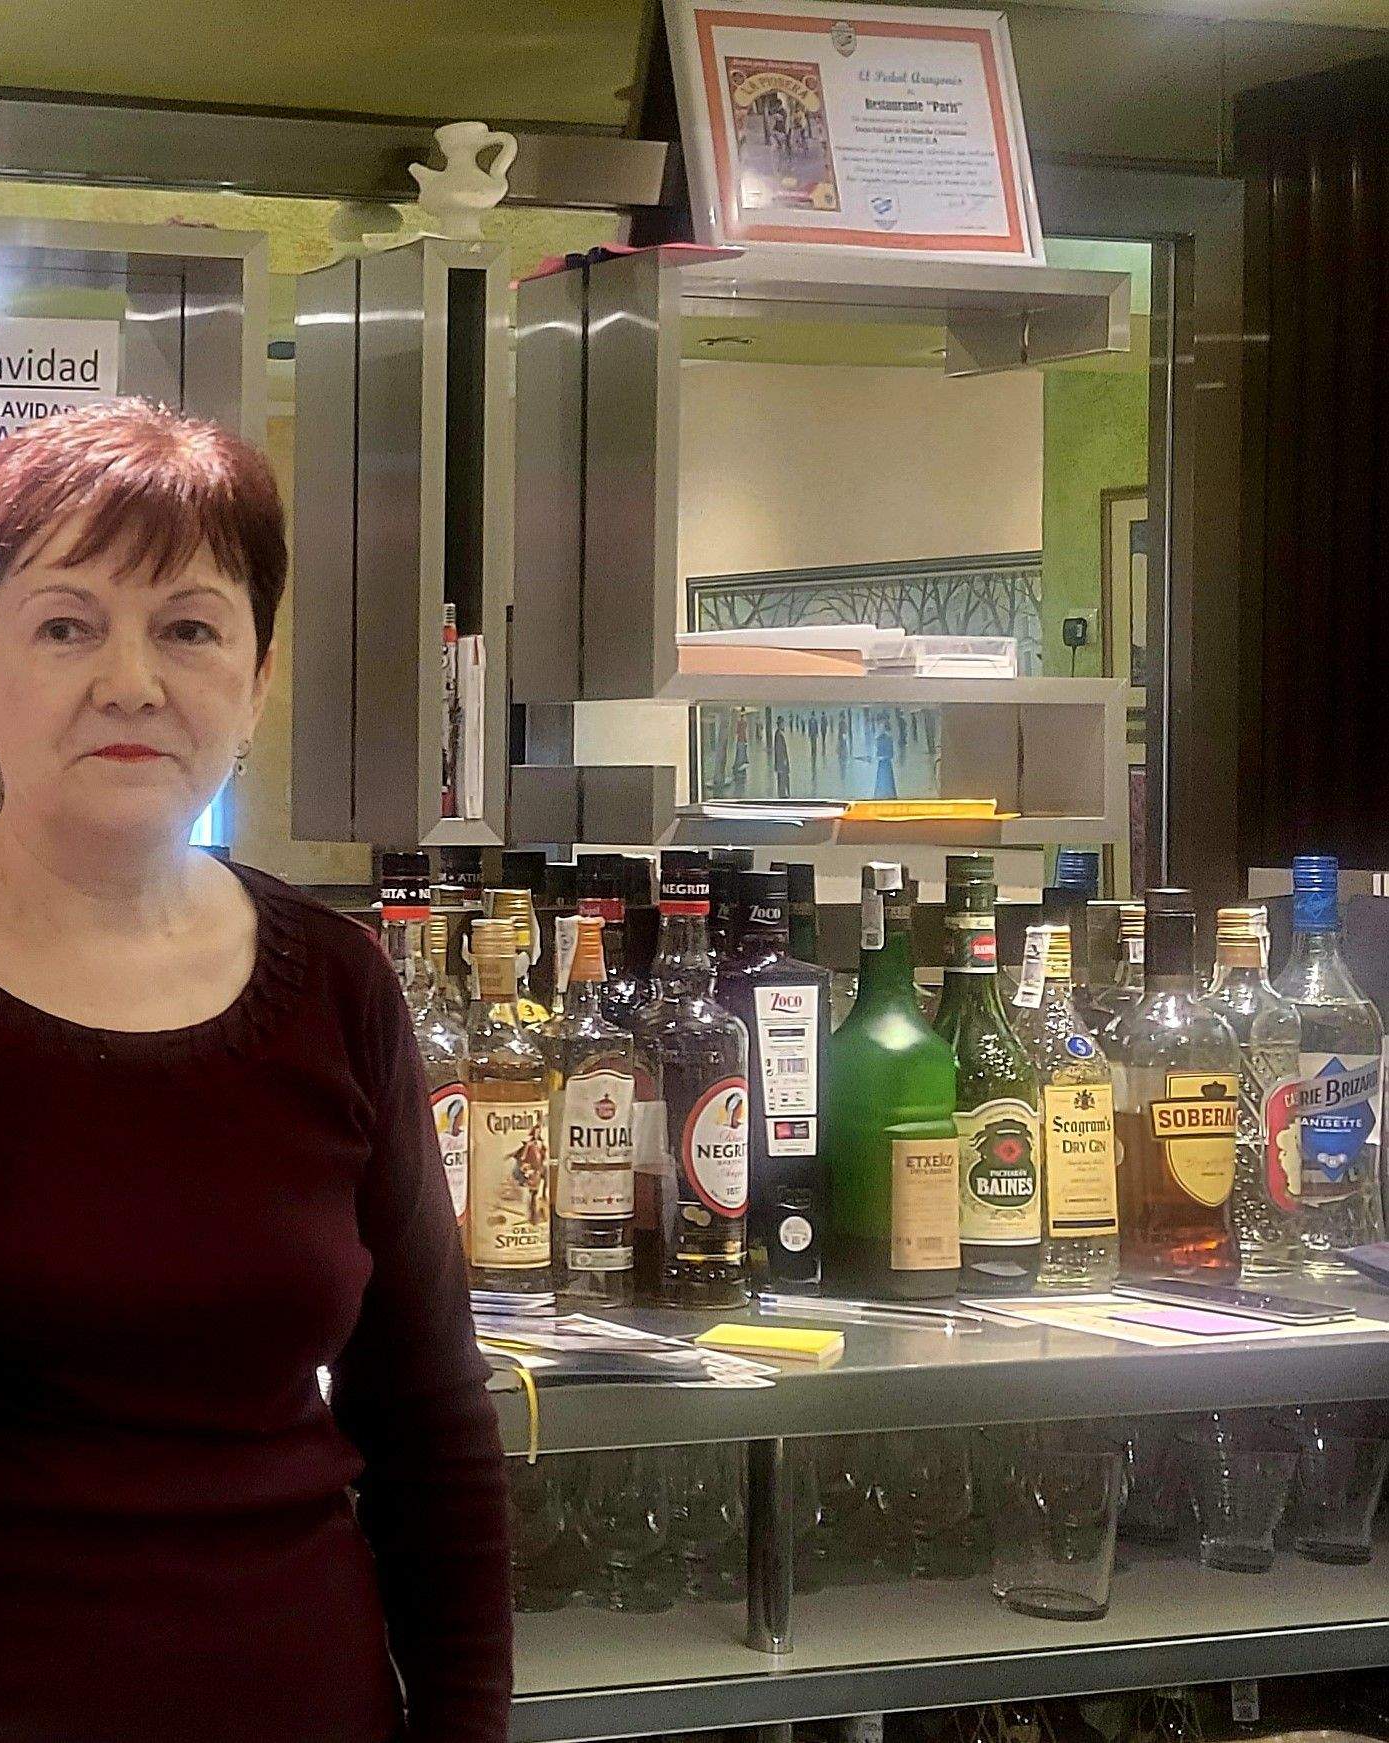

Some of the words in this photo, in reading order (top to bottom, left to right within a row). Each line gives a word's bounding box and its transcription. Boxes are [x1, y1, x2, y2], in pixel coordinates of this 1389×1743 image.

[662, 883, 709, 895] NEGRITA
[486, 1110, 533, 1135] Captain
[1052, 1115, 1111, 1137] Seagram's
[1301, 1117, 1363, 1128] ANISETTE
[1062, 1140, 1086, 1153] DRY
[977, 1177, 1033, 1196] BAINES
